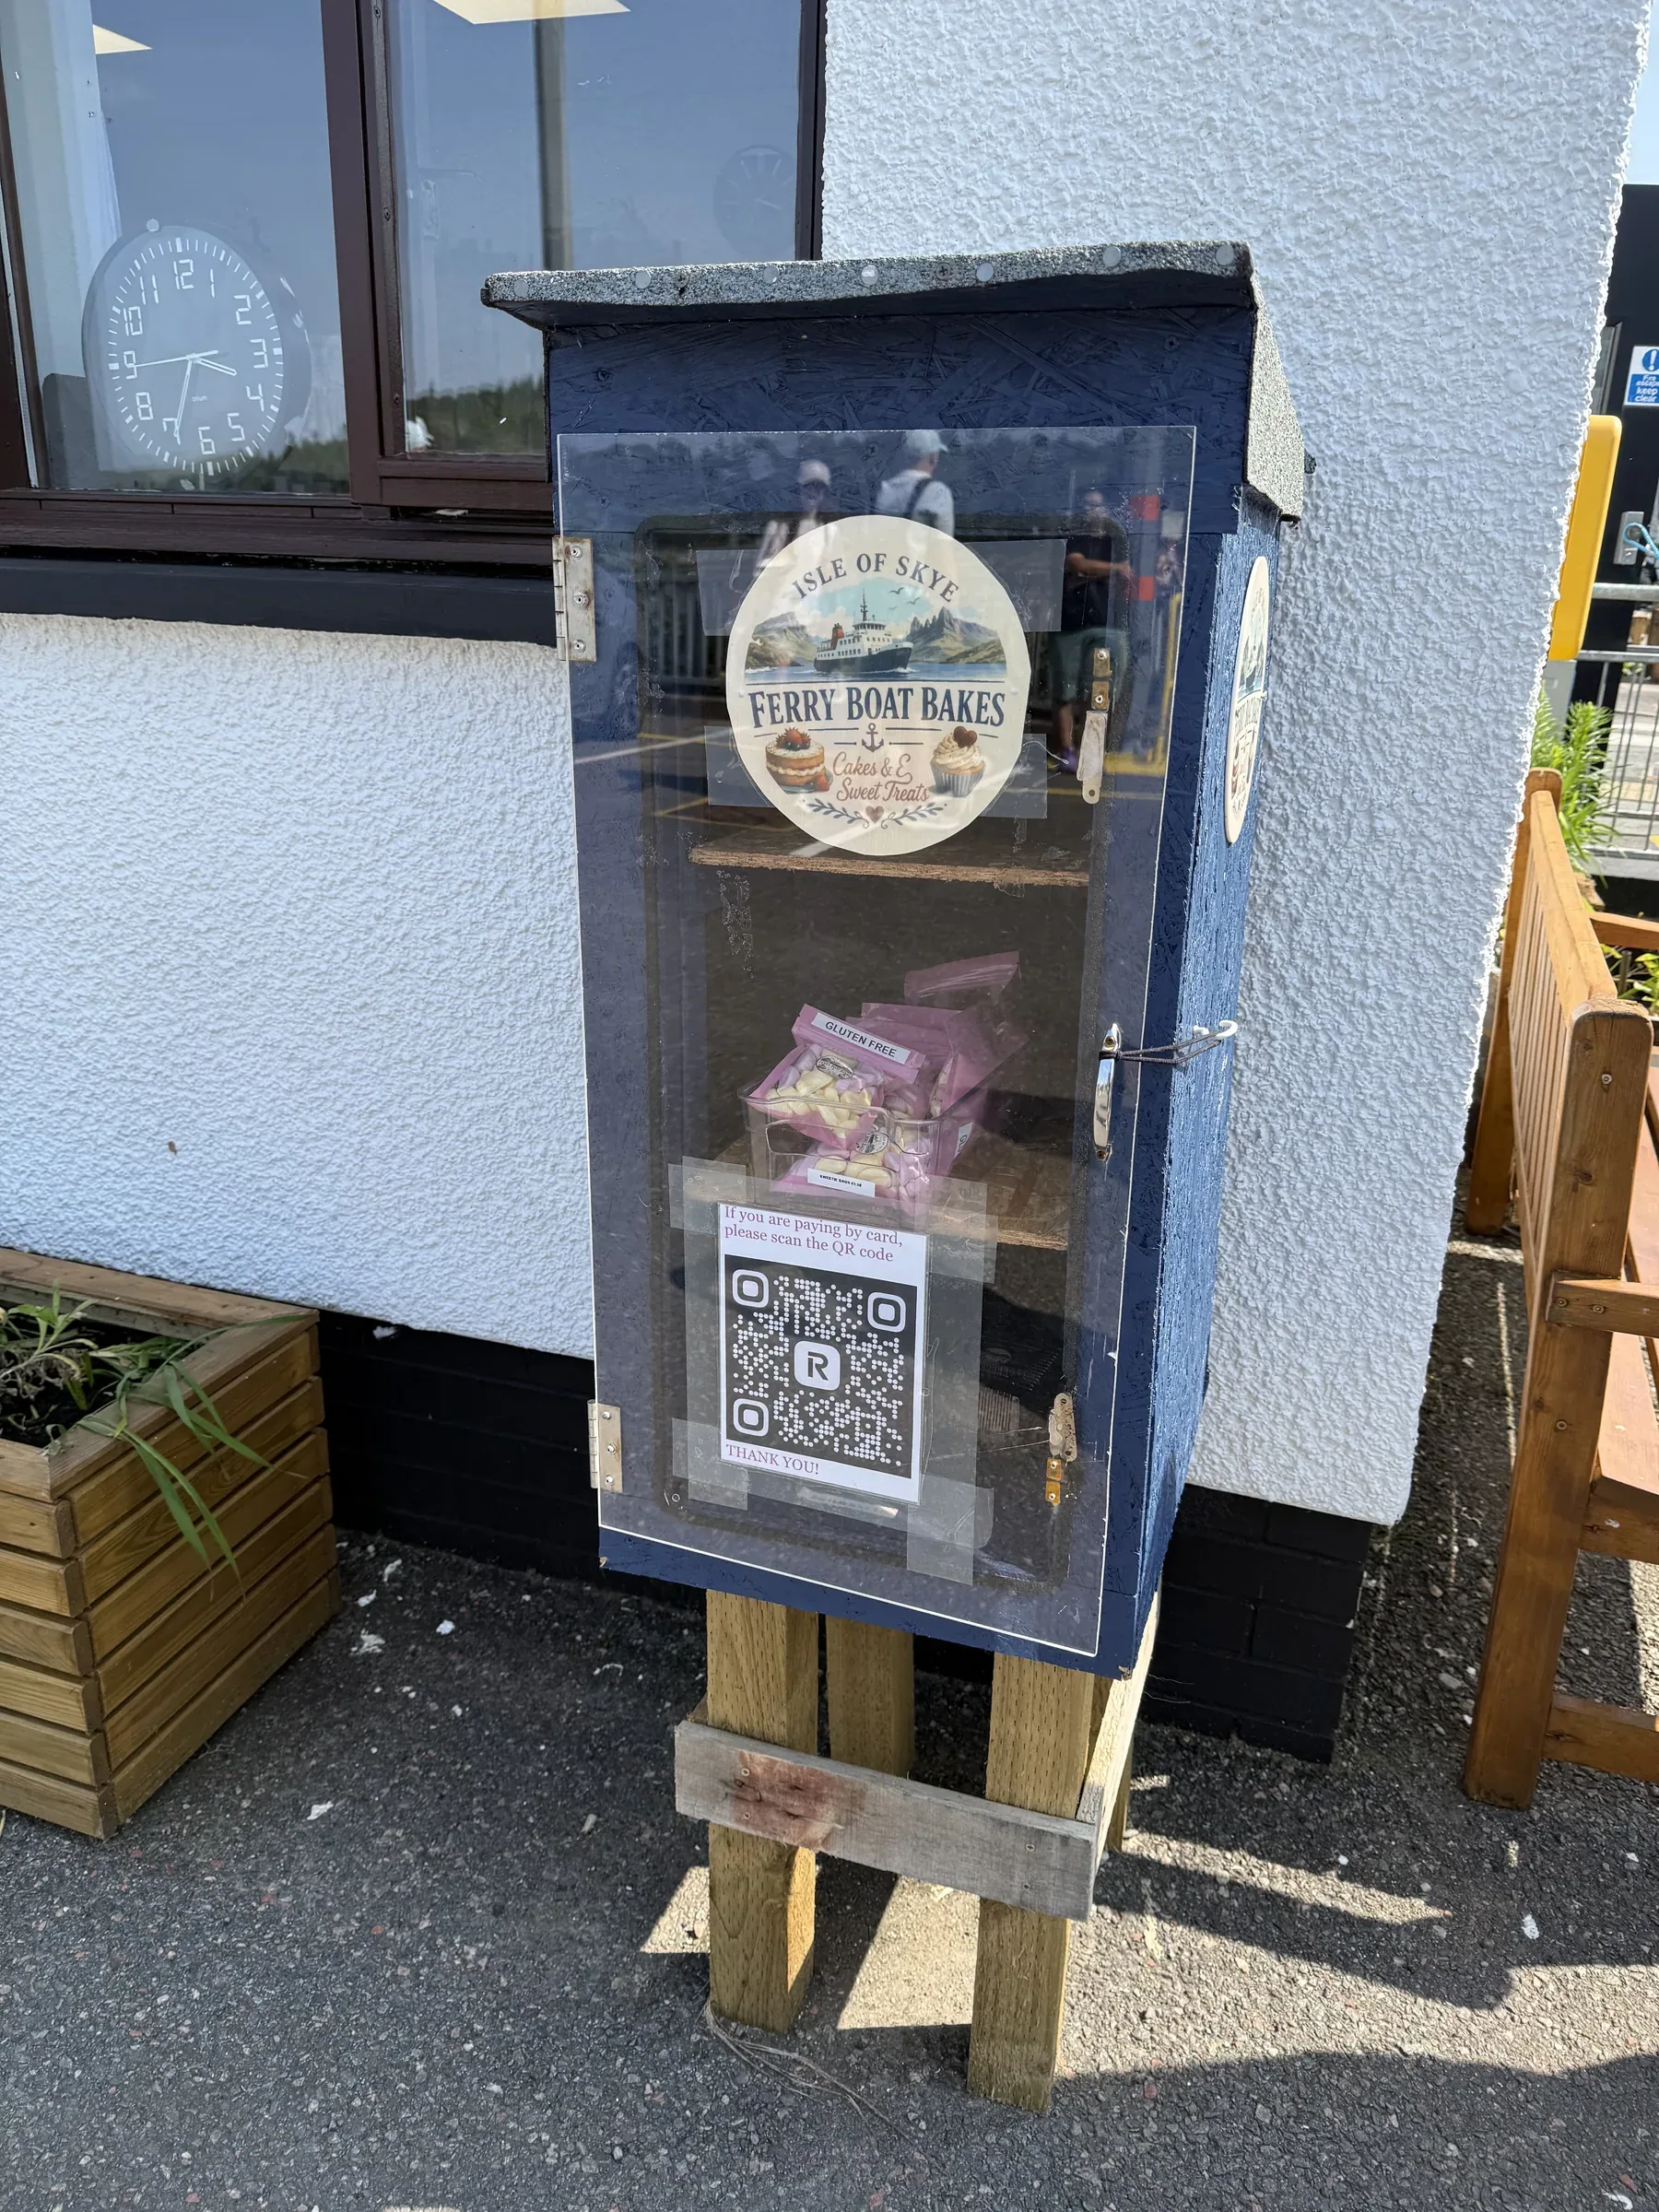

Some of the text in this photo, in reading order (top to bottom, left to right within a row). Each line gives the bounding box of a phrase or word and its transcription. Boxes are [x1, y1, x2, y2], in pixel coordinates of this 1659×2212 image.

[173, 259, 194, 289] 12
[210, 269, 215, 298] 1
[140, 275, 159, 305] 11
[124, 306, 143, 336] 10
[234, 294, 252, 324] 2
[124, 350, 137, 380] 9
[250, 338, 268, 369] 3
[135, 392, 154, 420] 8
[246, 383, 265, 412] 4
[1637, 387, 1657, 395] keep
[162, 418, 181, 444] 7
[198, 426, 216, 454] 6
[227, 413, 245, 441] 5
[792, 553, 959, 602] ISLE OF SKYE
[748, 687, 1005, 728] FERRY BOAT BAKES
[832, 751, 877, 776] Cakes
[880, 758, 893, 778] &
[836, 777, 929, 801] Sweet Treats
[825, 1021, 897, 1058] GLUTEN FREE
[819, 1174, 838, 1182] SWEETIE
[724, 1205, 903, 1248] If you are paying by card,
[724, 1224, 893, 1262] please scan the QR code
[807, 1351, 829, 1381] R
[726, 1444, 819, 1475] THANK YOU!
